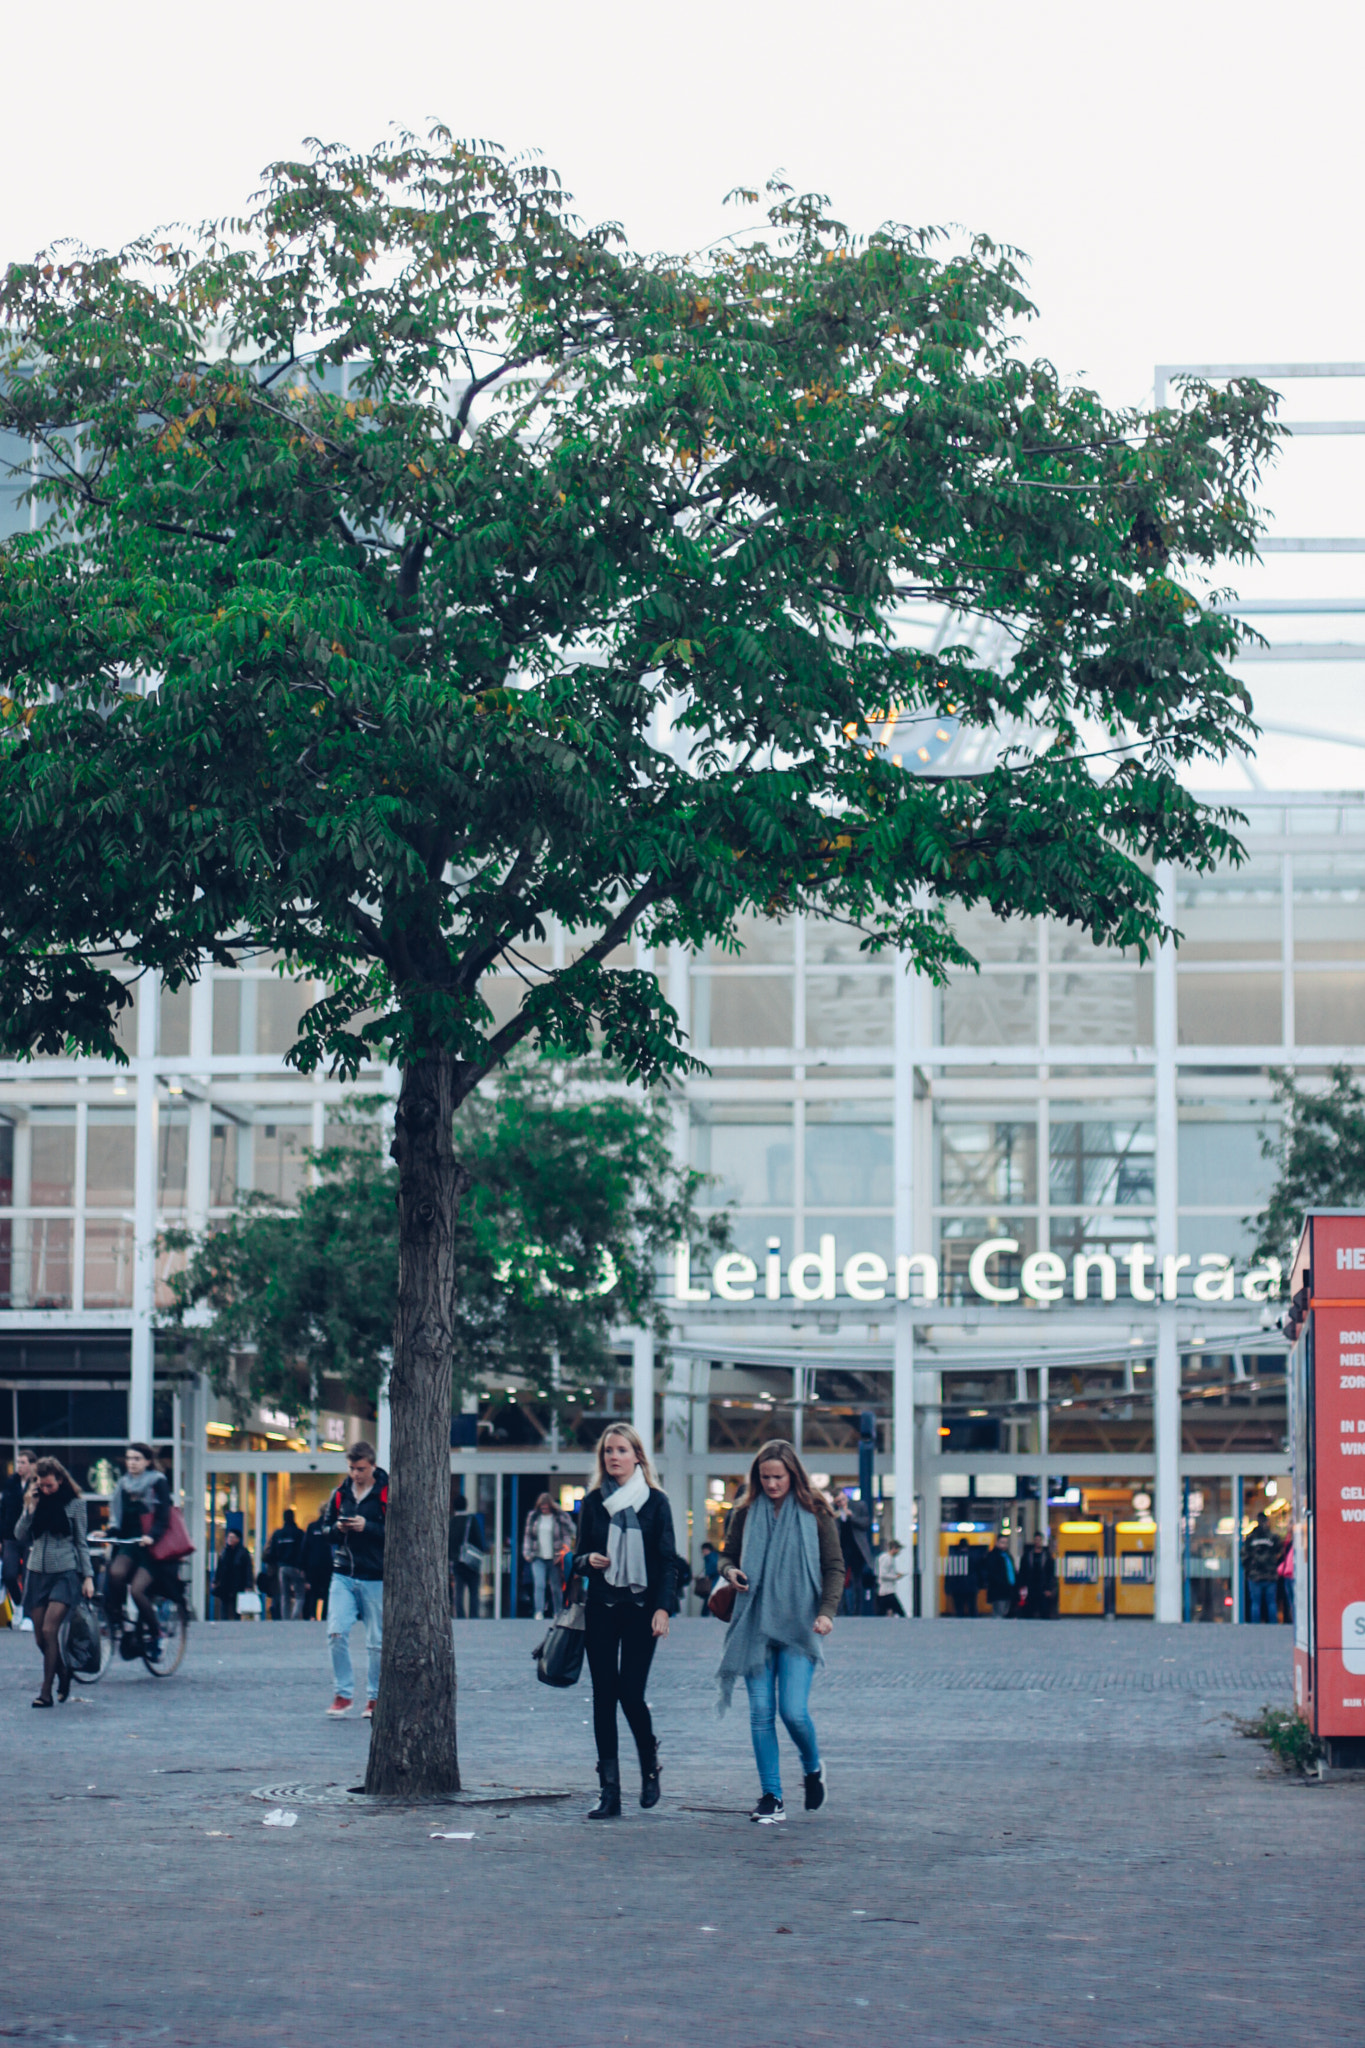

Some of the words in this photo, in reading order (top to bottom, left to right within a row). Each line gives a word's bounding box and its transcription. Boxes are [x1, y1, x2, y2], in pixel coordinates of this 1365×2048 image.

[675, 1233, 939, 1301] Leiden
[967, 1237, 1297, 1301] Centraa
[1340, 1419, 1355, 1433] IN
